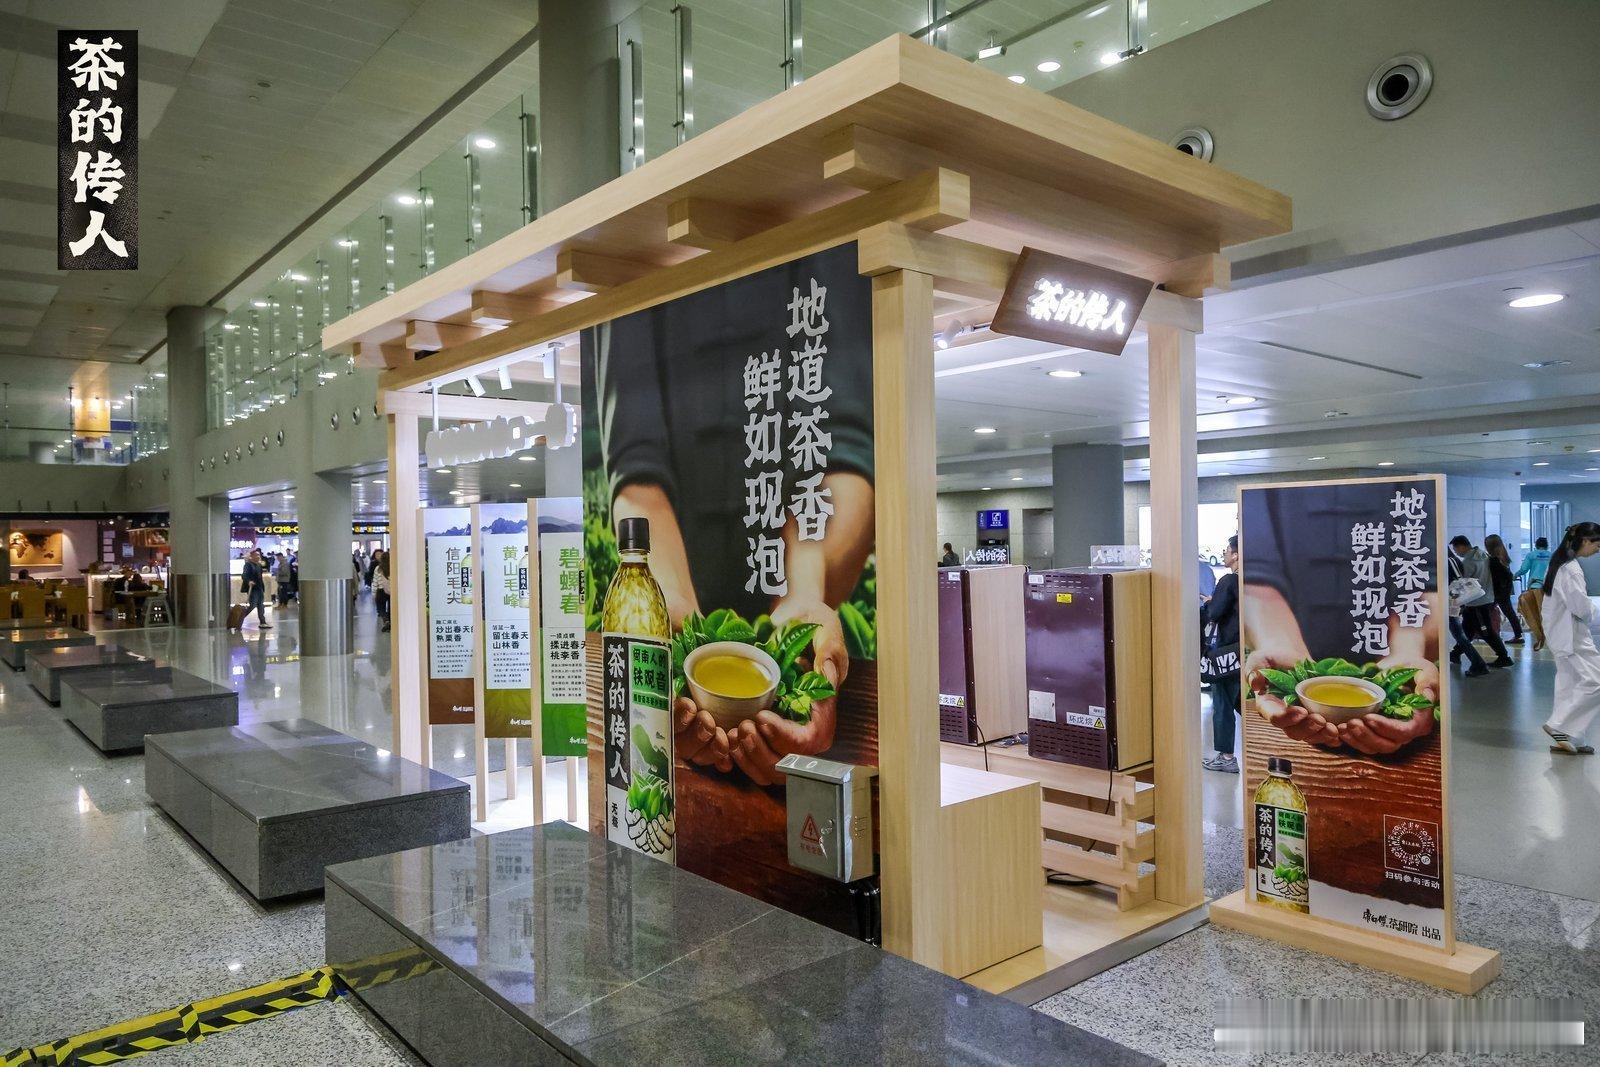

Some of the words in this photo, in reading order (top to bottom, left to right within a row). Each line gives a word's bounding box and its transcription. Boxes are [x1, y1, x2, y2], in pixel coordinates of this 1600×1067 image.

[1026, 277, 1127, 335] 茶的传人
[786, 277, 834, 541] 地道茶香
[743, 349, 788, 597] 鲜如现泡
[446, 547, 461, 604] 信阳毛尖
[503, 546, 519, 608] 黄山毛峰
[559, 547, 579, 614] 碧螺春
[1389, 488, 1431, 628] 地道茶香
[1350, 522, 1390, 656] 鲜如现泡
[492, 631, 529, 640] 留住春天
[492, 641, 520, 649] 山林香
[550, 651, 580, 660] 桃李香
[633, 666, 666, 691] 铁观音
[607, 643, 628, 784] 茶的传人
[1259, 807, 1275, 868] 茶的传人
[1385, 870, 1440, 889] 扫码参与活动
[1421, 925, 1441, 941] 出品
